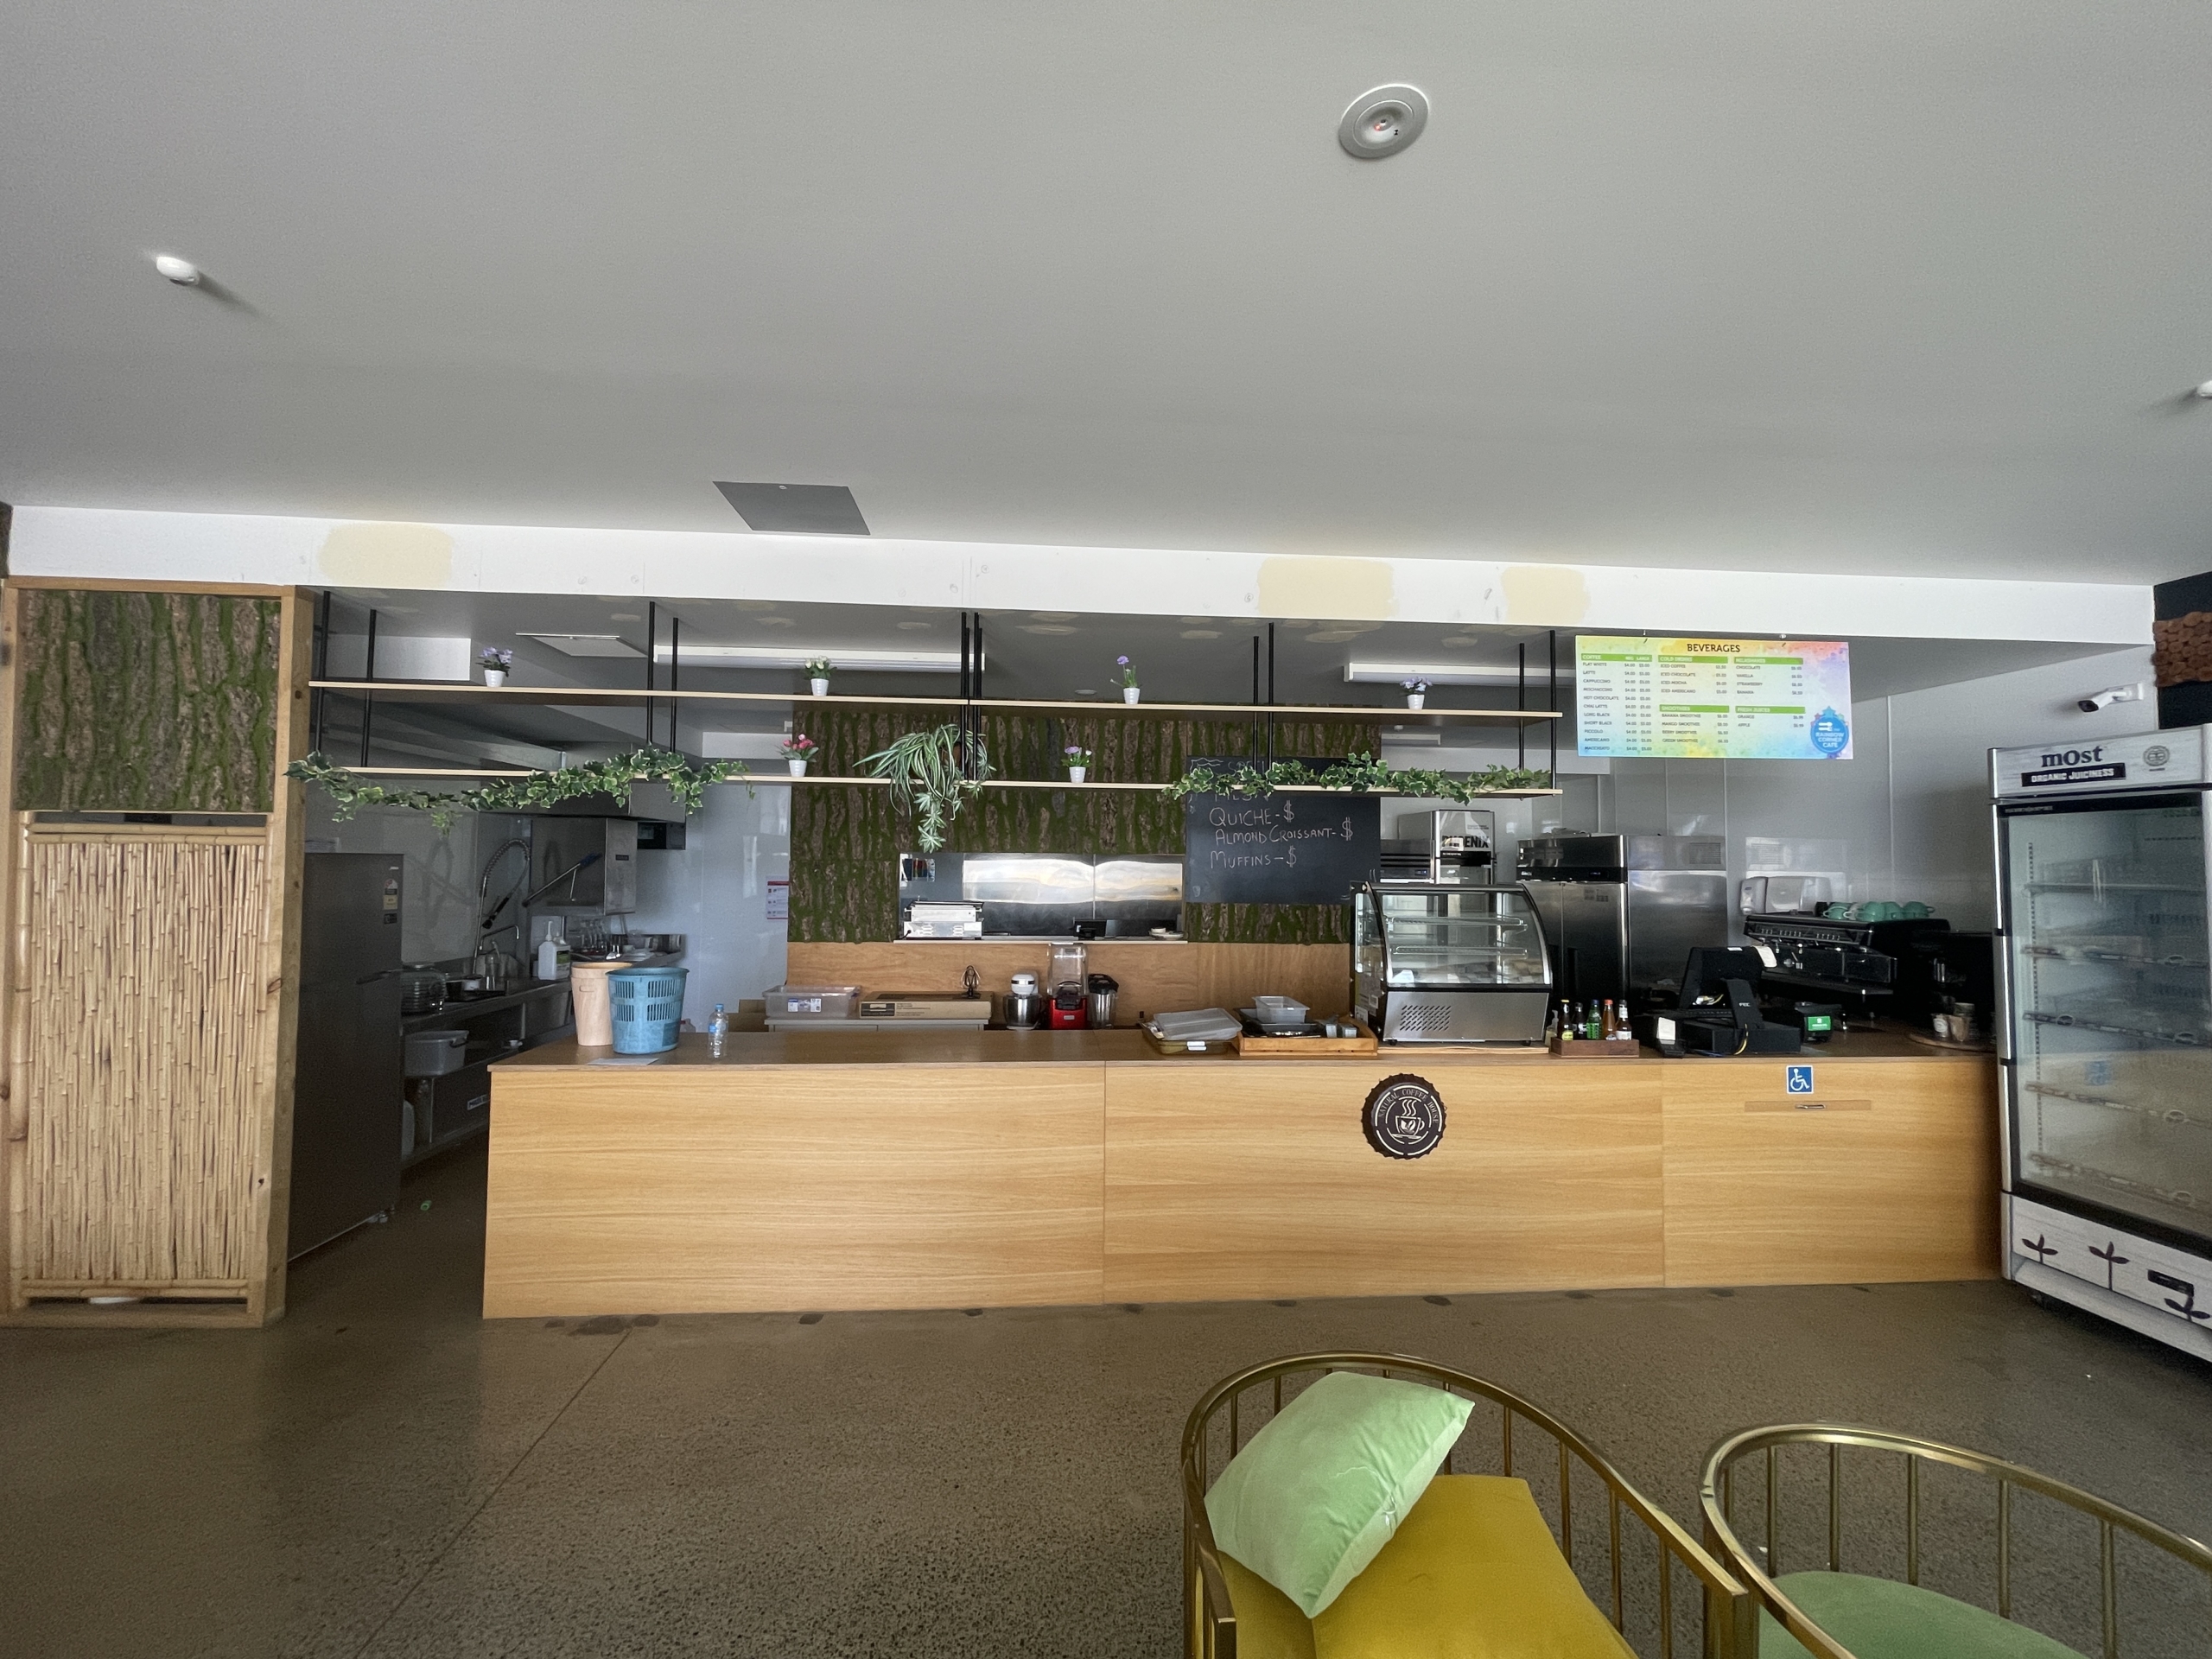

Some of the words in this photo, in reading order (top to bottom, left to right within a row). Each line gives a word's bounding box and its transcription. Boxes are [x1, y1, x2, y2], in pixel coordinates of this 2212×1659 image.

[1687, 644, 1740, 652] BEVERAGES
[2031, 773, 2067, 783] ORGANIC
[2069, 768, 2114, 780] JUICINESS
[1215, 828, 1267, 846] ALMOND
[1378, 1092, 1399, 1118] NATURAL
[1402, 1088, 1428, 1102] COFFEE
[1427, 1101, 1439, 1123] HOUSE
